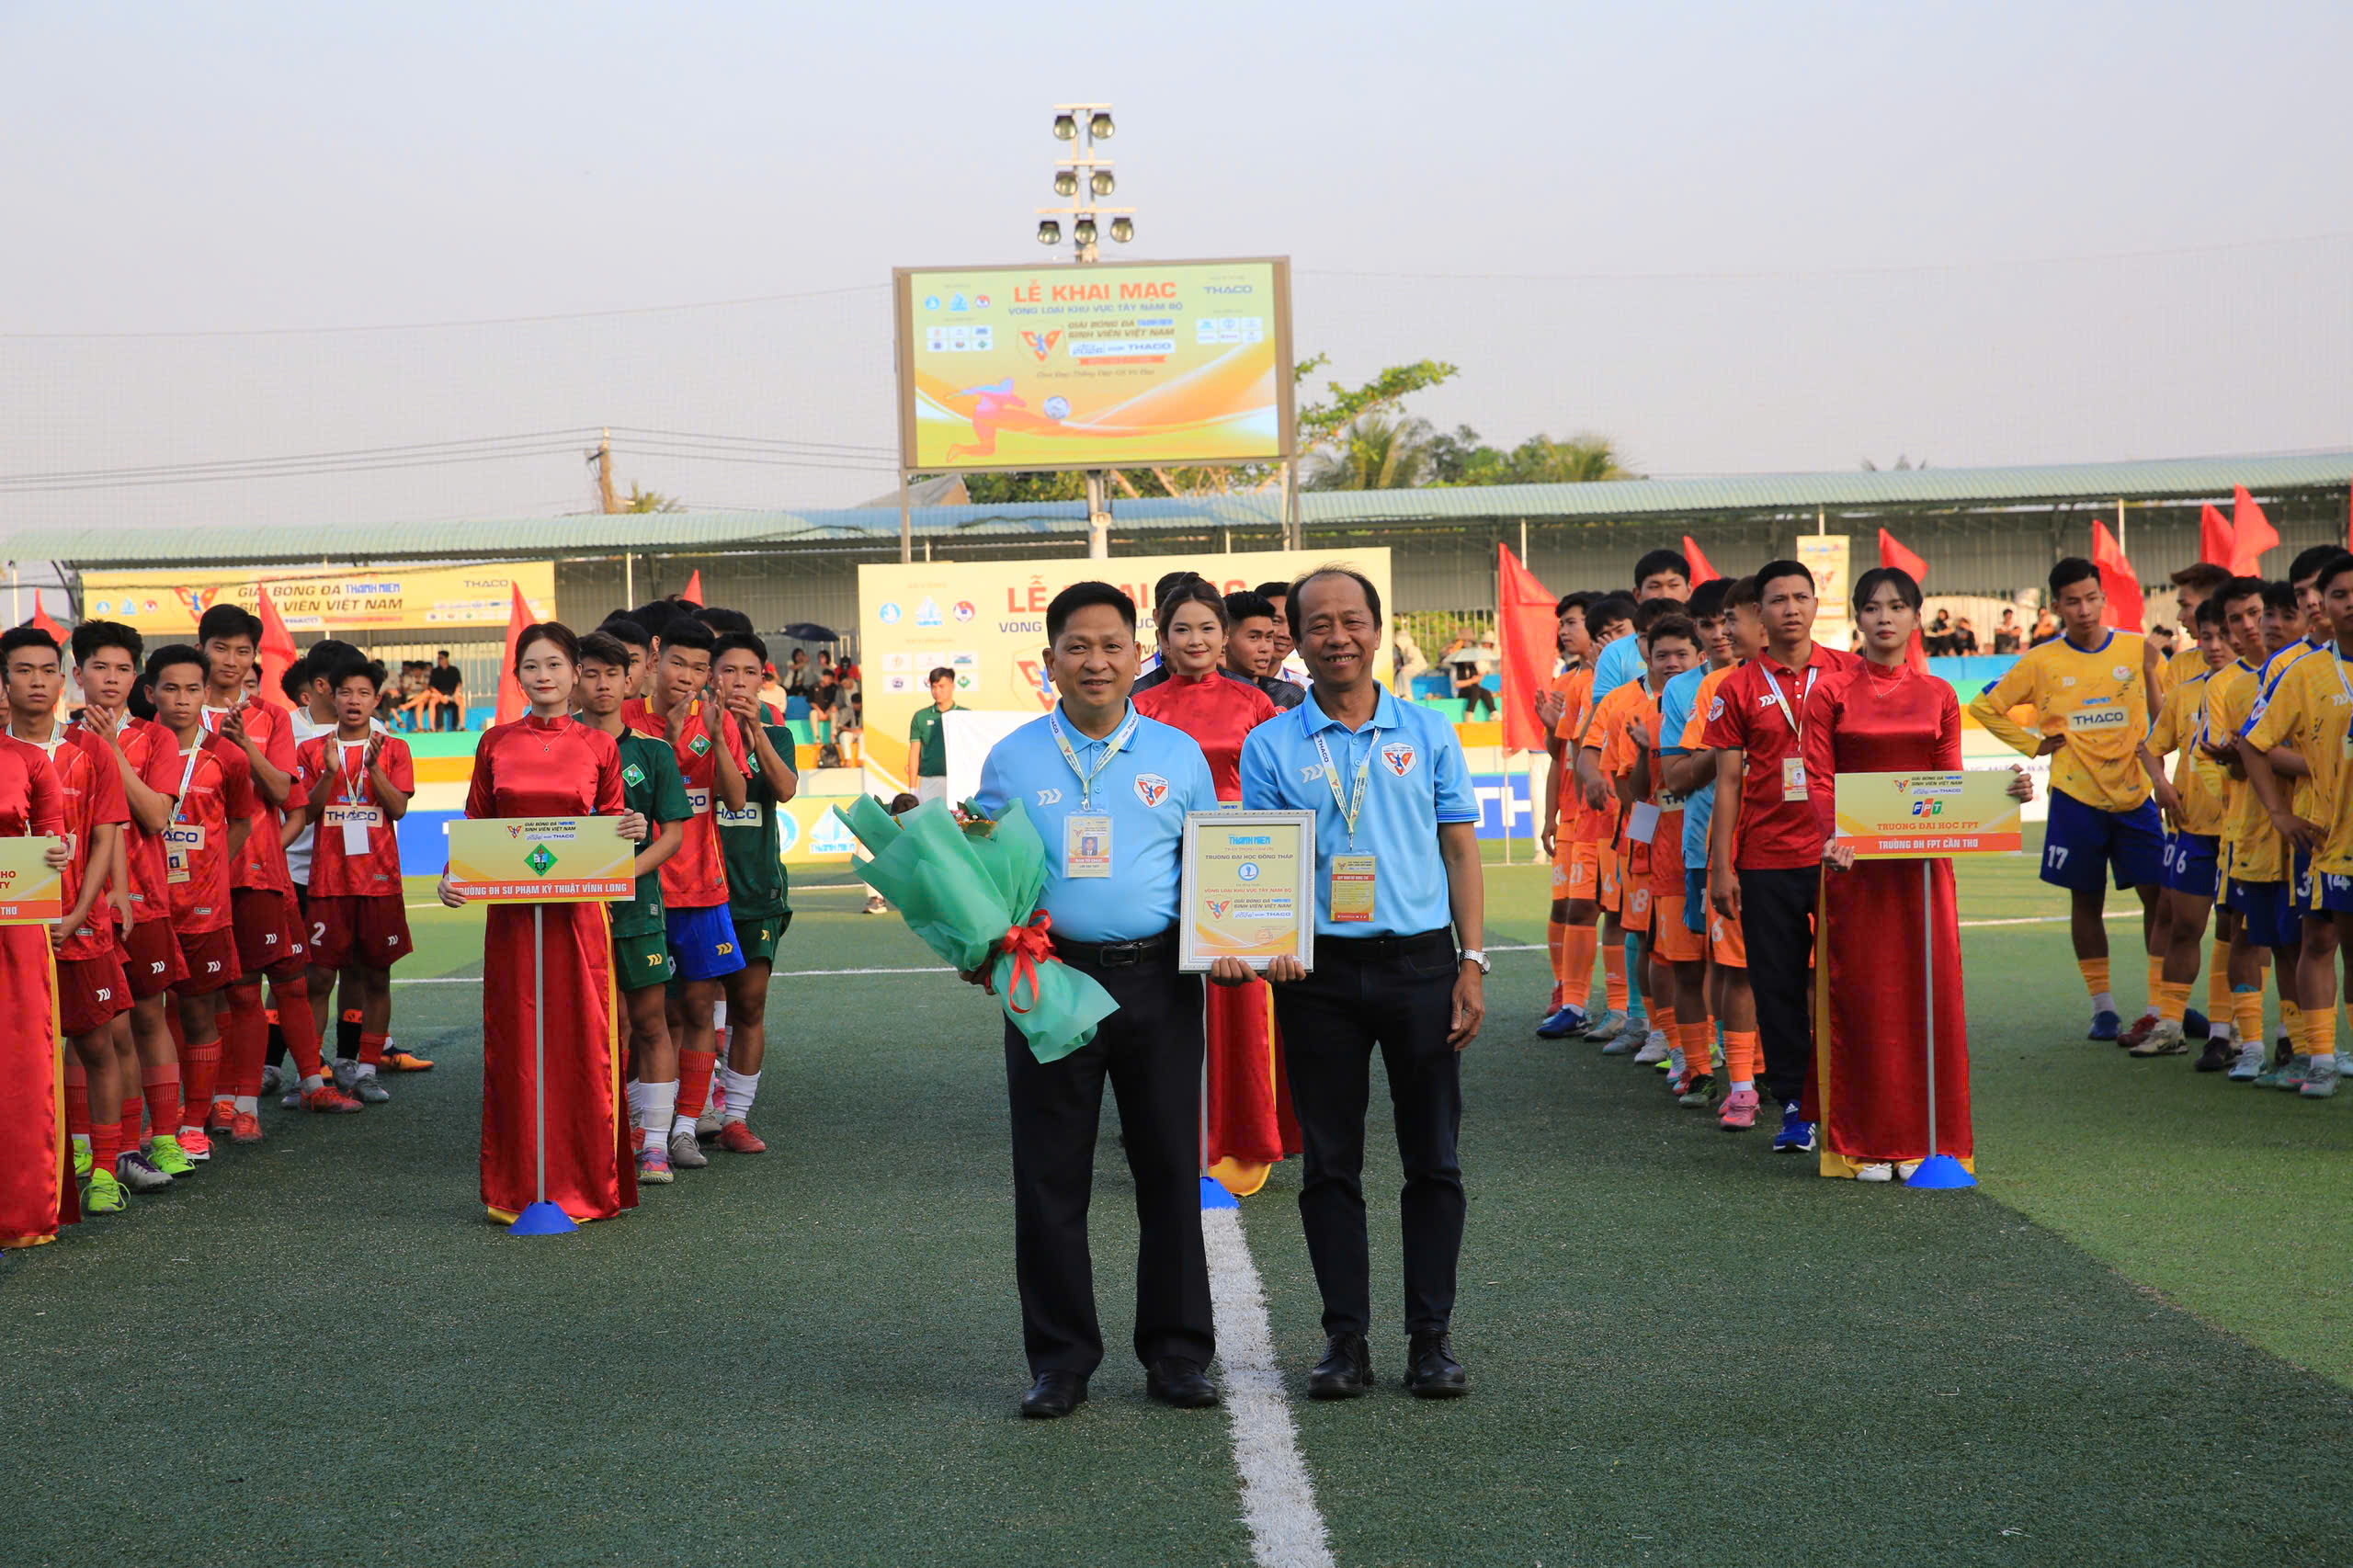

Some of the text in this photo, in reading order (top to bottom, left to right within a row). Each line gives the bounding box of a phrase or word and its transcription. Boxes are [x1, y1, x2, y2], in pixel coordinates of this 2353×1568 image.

[1051, 284, 1111, 301] KHAI
[1120, 281, 1177, 302] MẠC
[1203, 285, 1253, 295] THACO
[463, 580, 508, 589] THACO
[1007, 574, 1047, 613] LỄ
[365, 598, 403, 609] NAM
[2073, 711, 2124, 725] THACO
[1317, 739, 1329, 763] THACO
[1927, 839, 1941, 848] FPT
[2048, 846, 2068, 870] 17
[2176, 850, 2187, 873] 6
[605, 883, 627, 892] LONG
[310, 921, 326, 946] 2
